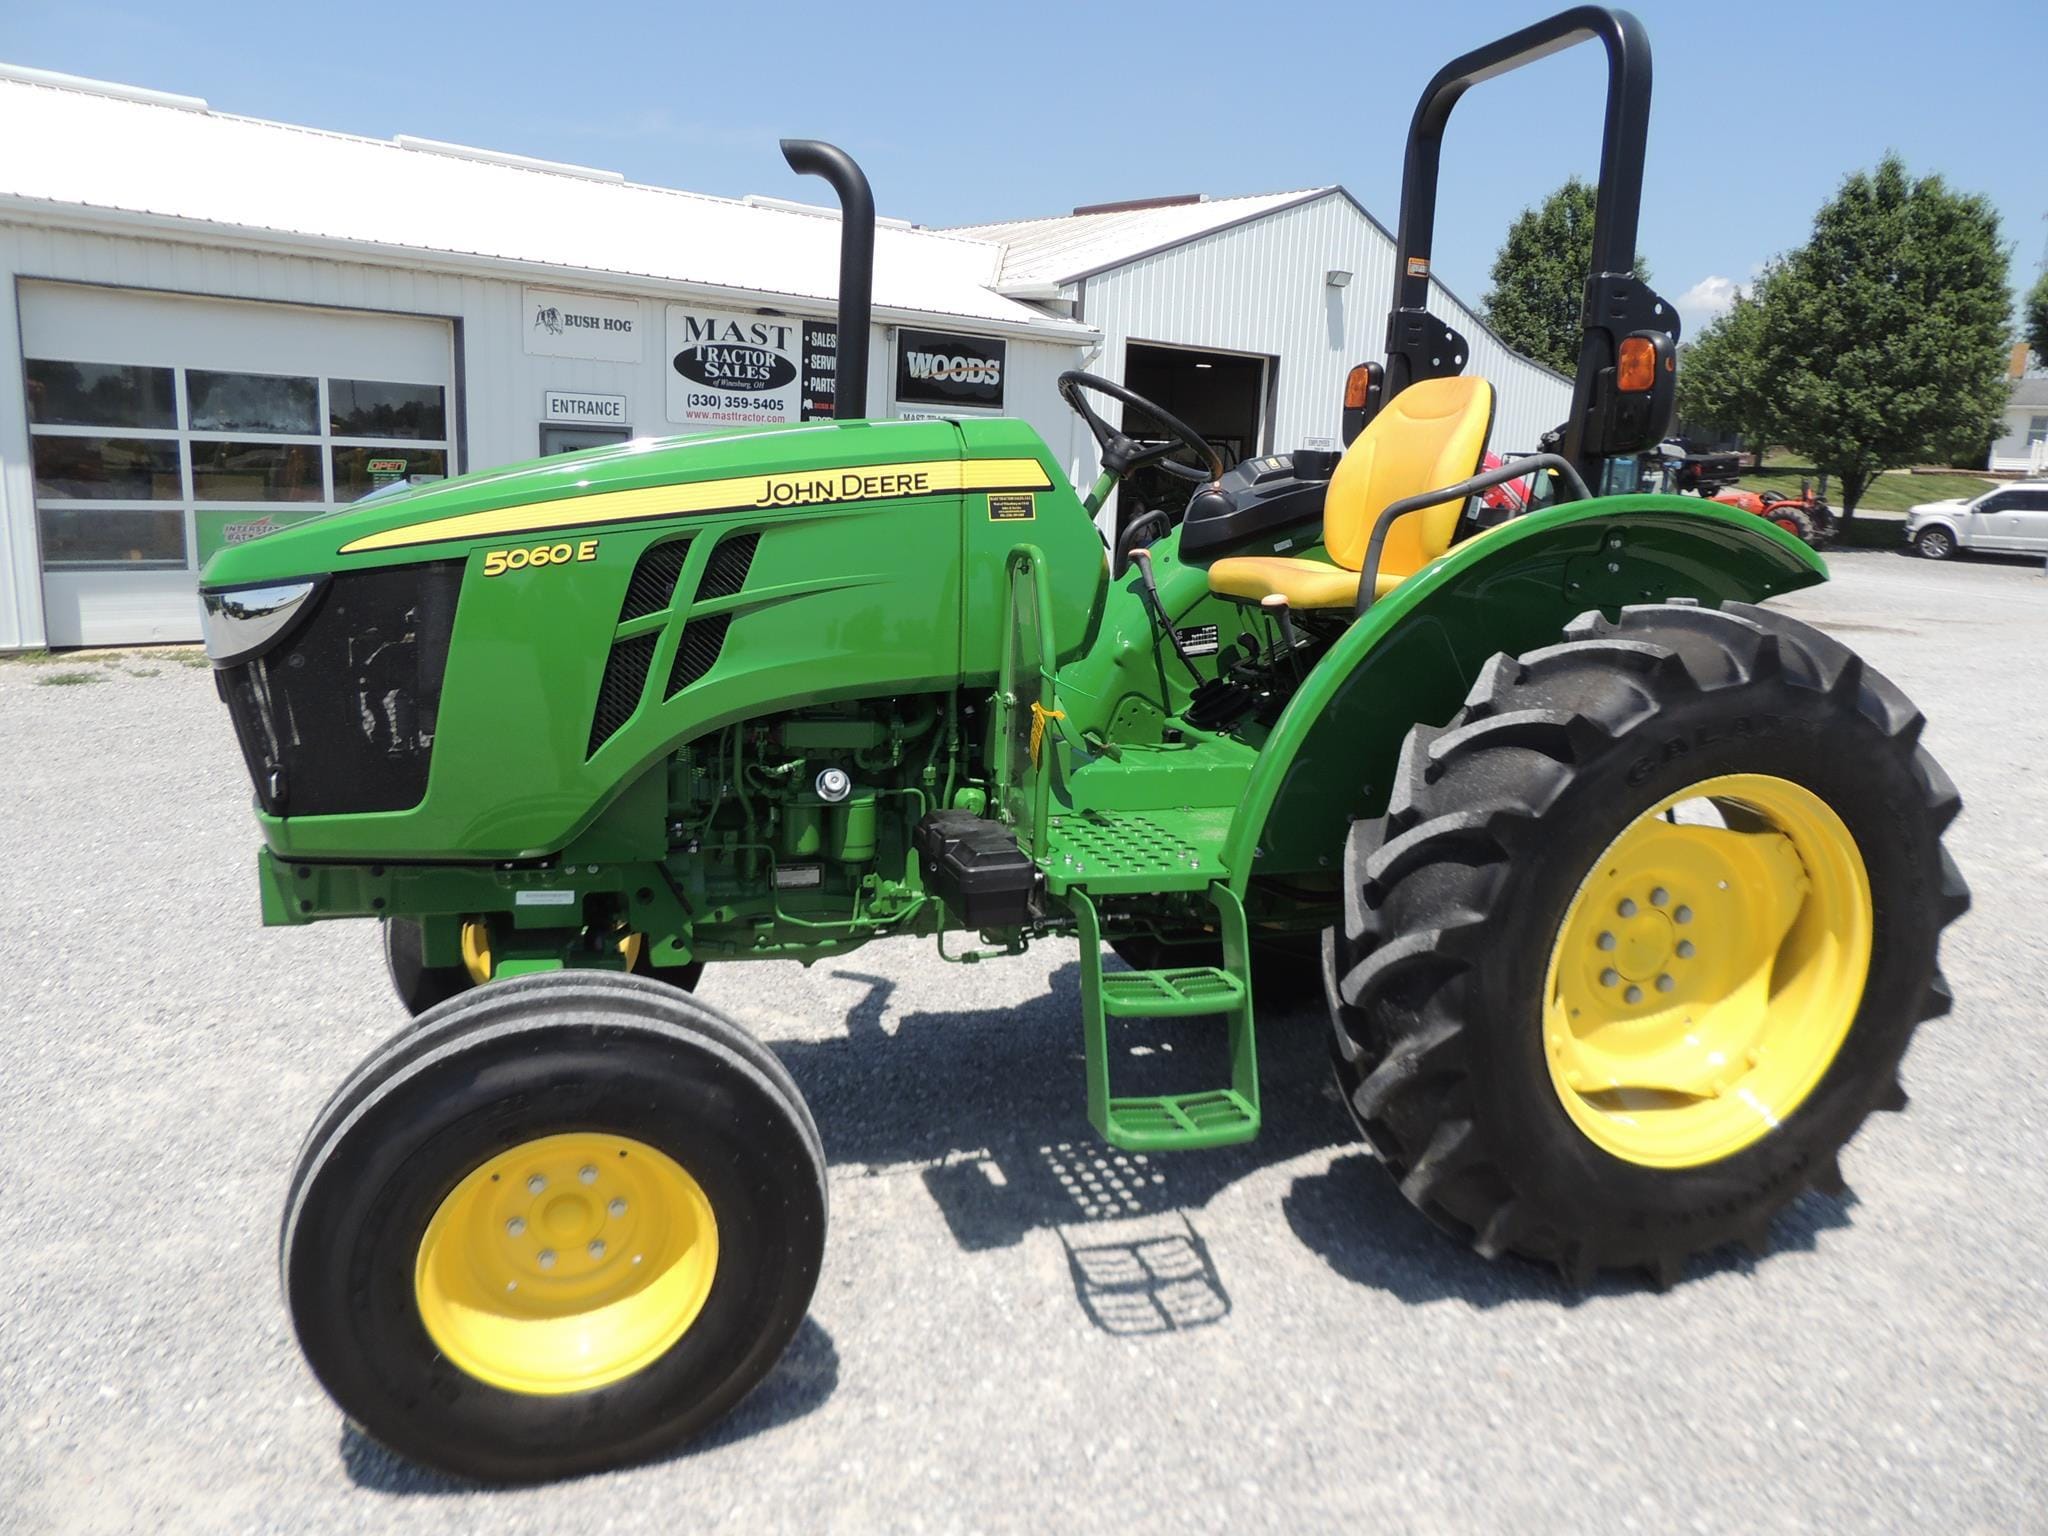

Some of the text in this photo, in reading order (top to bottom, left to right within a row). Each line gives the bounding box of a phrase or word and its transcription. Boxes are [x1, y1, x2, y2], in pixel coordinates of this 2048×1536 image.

[564, 314, 632, 333] BUSH HOG
[684, 316, 793, 351] MAST
[811, 331, 837, 348] SALES
[692, 344, 777, 367] TRACTOR
[811, 354, 837, 371] SERVI
[704, 362, 771, 380] SALES
[907, 351, 1001, 385] WOODS
[754, 381, 766, 389] OH
[810, 376, 836, 393] PARTS
[552, 398, 620, 416] ENTRANCE
[687, 394, 784, 411] (330) 359-5405
[686, 410, 786, 424] www.masttractor.com
[372, 462, 404, 470] OPEN
[756, 472, 929, 504] JOHN DEERE
[483, 540, 599, 577] 5060 E
